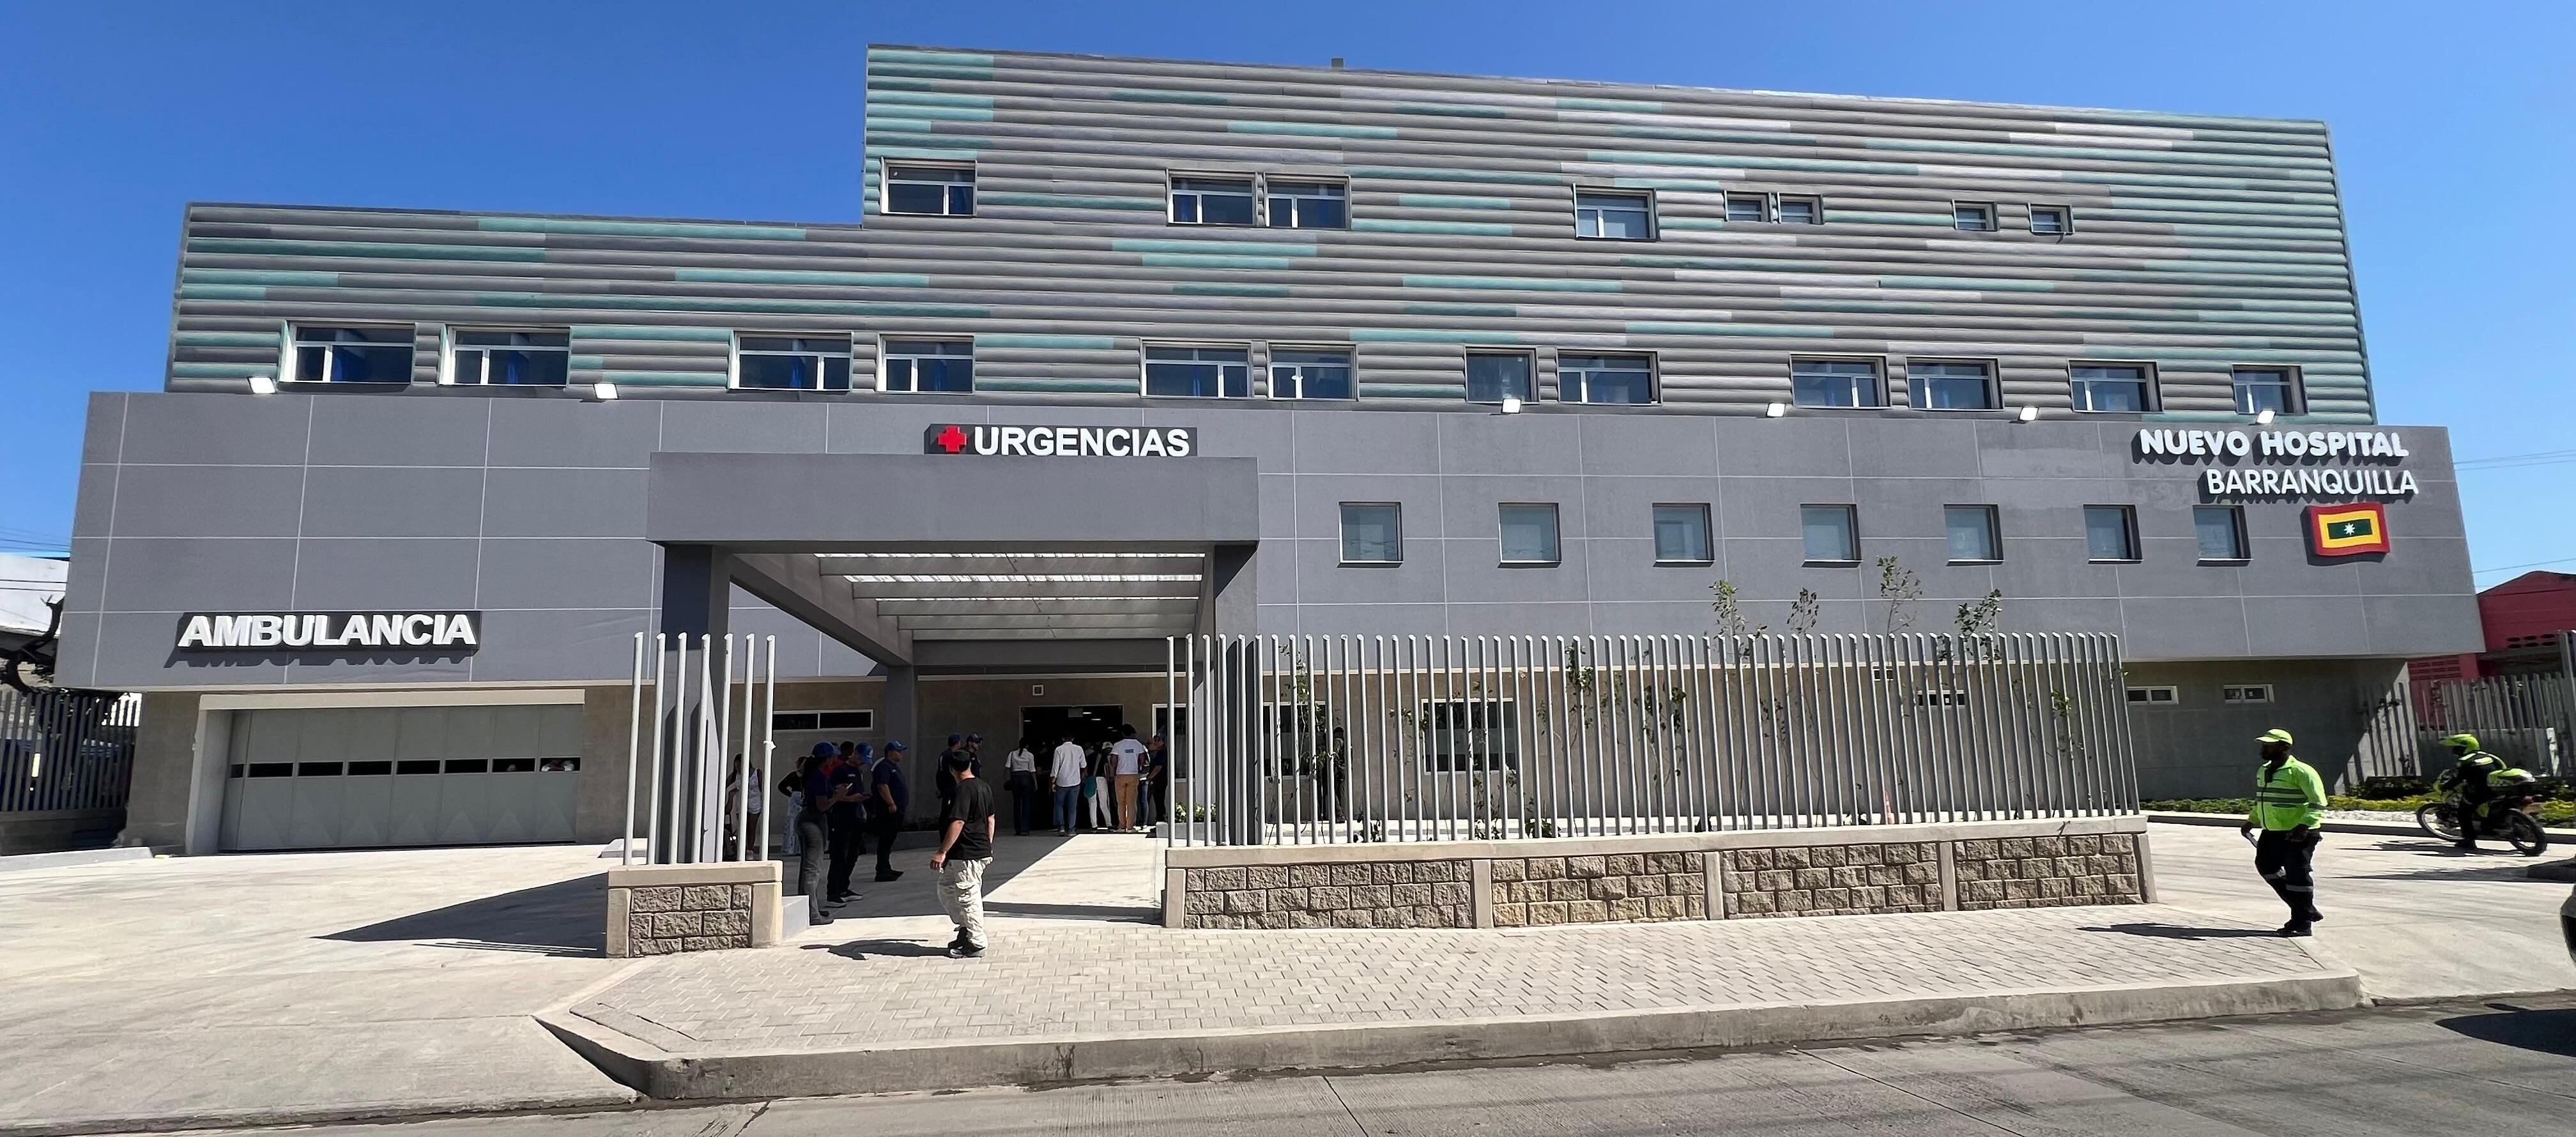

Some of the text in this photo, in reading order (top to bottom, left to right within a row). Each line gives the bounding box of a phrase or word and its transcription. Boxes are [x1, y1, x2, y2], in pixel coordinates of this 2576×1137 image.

[974, 427, 1190, 457] URGENCIAS
[2140, 429, 2409, 457] NUEVO HOSPITAL
[2206, 469, 2419, 495] BARRANQUILLA
[177, 614, 477, 646] AMBULANCIA
